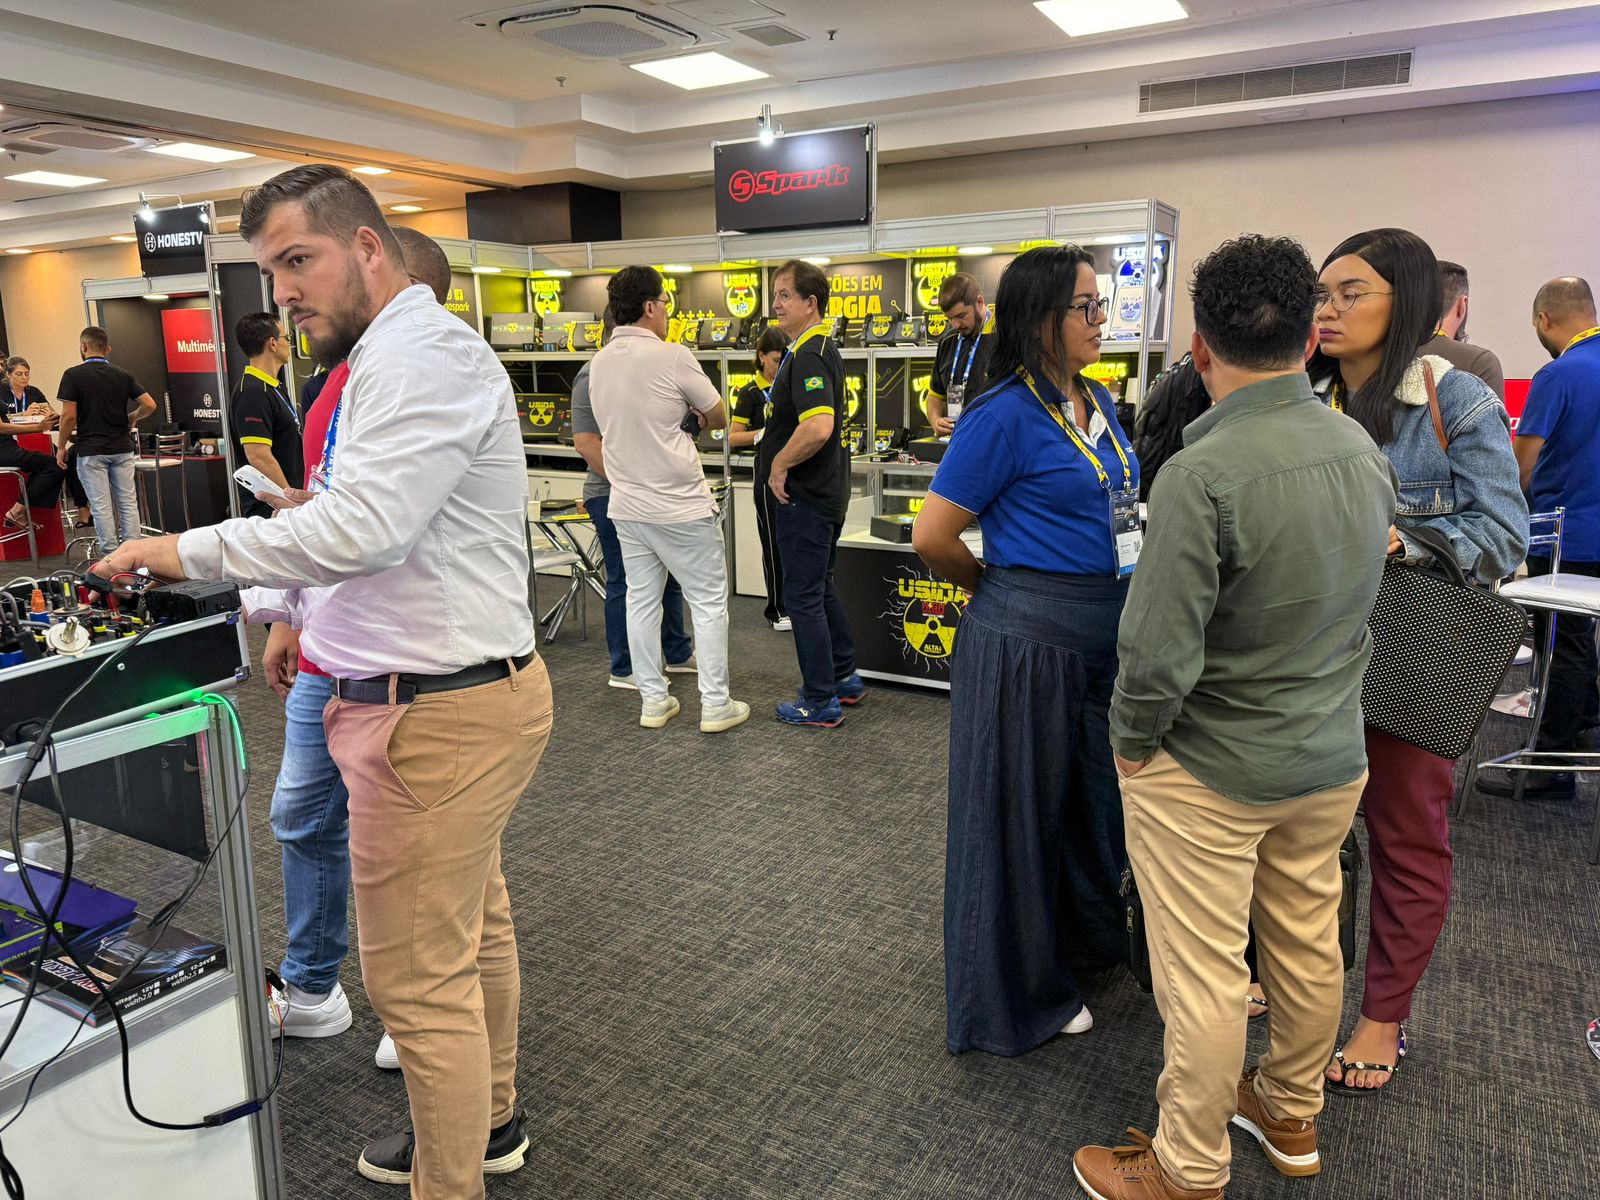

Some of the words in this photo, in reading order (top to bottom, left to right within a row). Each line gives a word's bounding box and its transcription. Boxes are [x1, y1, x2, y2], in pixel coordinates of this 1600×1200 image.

[755, 164, 849, 195] Spark
[861, 274, 883, 291] EM
[825, 295, 882, 318] RGIA
